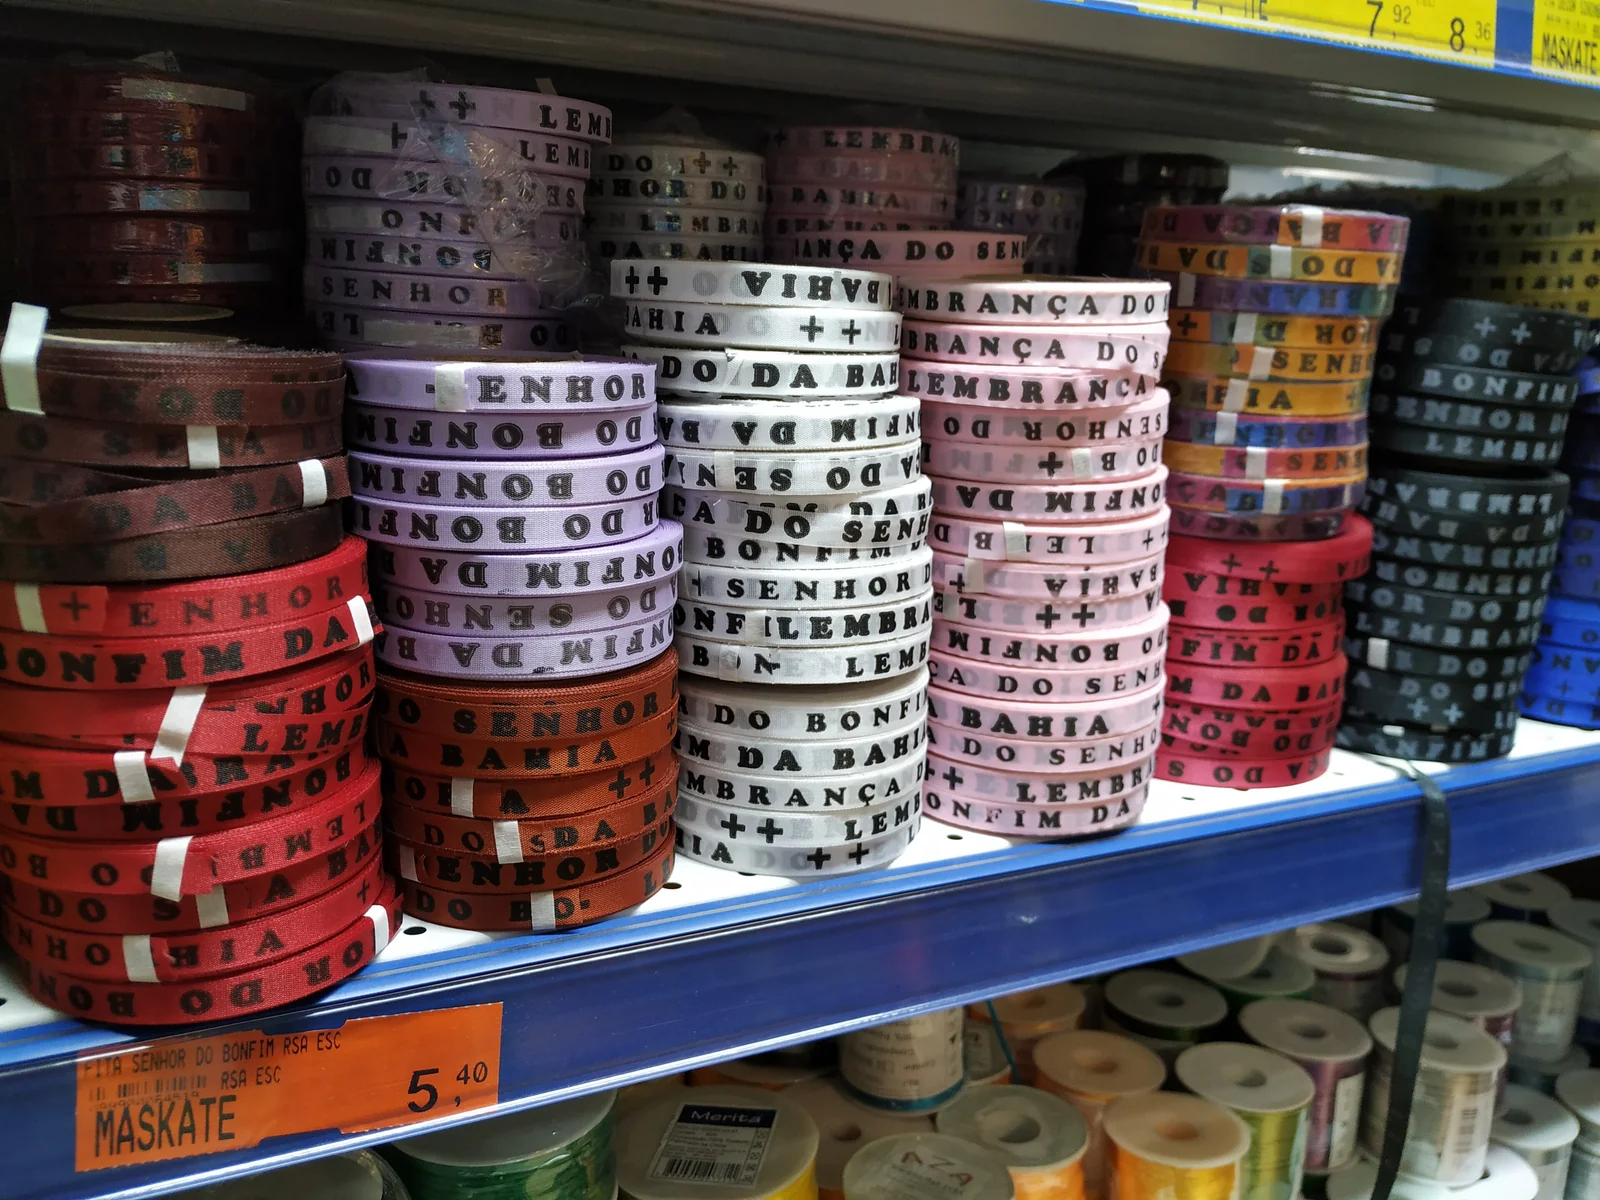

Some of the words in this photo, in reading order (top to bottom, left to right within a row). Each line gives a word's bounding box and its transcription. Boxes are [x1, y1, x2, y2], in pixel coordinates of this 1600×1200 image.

[1541, 31, 1597, 76] MASKATE
[607, 154, 653, 172] DO
[601, 240, 644, 258] DA
[905, 240, 955, 260] DO
[1179, 247, 1228, 271] DA
[1302, 255, 1356, 278] DO
[322, 275, 506, 307] SENHOR
[741, 270, 880, 304] BAHIA
[1120, 294, 1155, 315] DO
[1097, 340, 1139, 364] DO
[661, 355, 718, 382] DO
[751, 362, 819, 389] DA
[477, 372, 646, 404] ENHOR
[356, 413, 564, 450] BONFIM
[595, 415, 642, 447] DO
[731, 421, 797, 446] DA
[943, 416, 991, 440] DO
[1023, 412, 1162, 442] SENHOR
[361, 461, 574, 501] BONFIM
[605, 463, 651, 496] DO
[826, 462, 882, 490] DO
[955, 485, 1015, 512] DA
[562, 508, 624, 541] DO
[745, 508, 811, 540] DO
[419, 556, 488, 588] DA
[726, 571, 911, 601] SENHOR
[1043, 563, 1158, 597] BAHIA
[128, 575, 346, 628] ENHOR
[606, 585, 658, 621] DO
[1447, 600, 1503, 623] DO
[282, 615, 350, 660] DA
[948, 629, 1120, 663] BONFIM
[1281, 641, 1321, 663] DA
[447, 641, 524, 670] DA
[1437, 653, 1490, 679] DO
[997, 675, 1053, 696] DO
[1221, 682, 1273, 703] DA
[452, 691, 660, 739] SENHOR
[713, 703, 771, 730] DO
[960, 705, 1109, 737] BAHIA
[440, 739, 618, 771] BAHIA
[963, 737, 1016, 762] DO
[1273, 732, 1313, 752] DO
[737, 744, 802, 772] DA
[1213, 766, 1264, 784] DO
[12, 802, 78, 833] DA
[1092, 798, 1130, 824] DA
[423, 822, 485, 852] DO
[40, 886, 108, 919] DO
[415, 888, 473, 921] DO
[179, 979, 263, 1016] DO
[131, 1048, 186, 1074] SENHOR
[195, 1046, 213, 1066] DO
[222, 1037, 275, 1064] BONFIM
[283, 1034, 309, 1057] RSA
[316, 1031, 342, 1051] ESC
[220, 1070, 247, 1090] RSA
[255, 1065, 281, 1086] ESC
[94, 1094, 238, 1158] MASKATE
[690, 1110, 762, 1124] Merita
